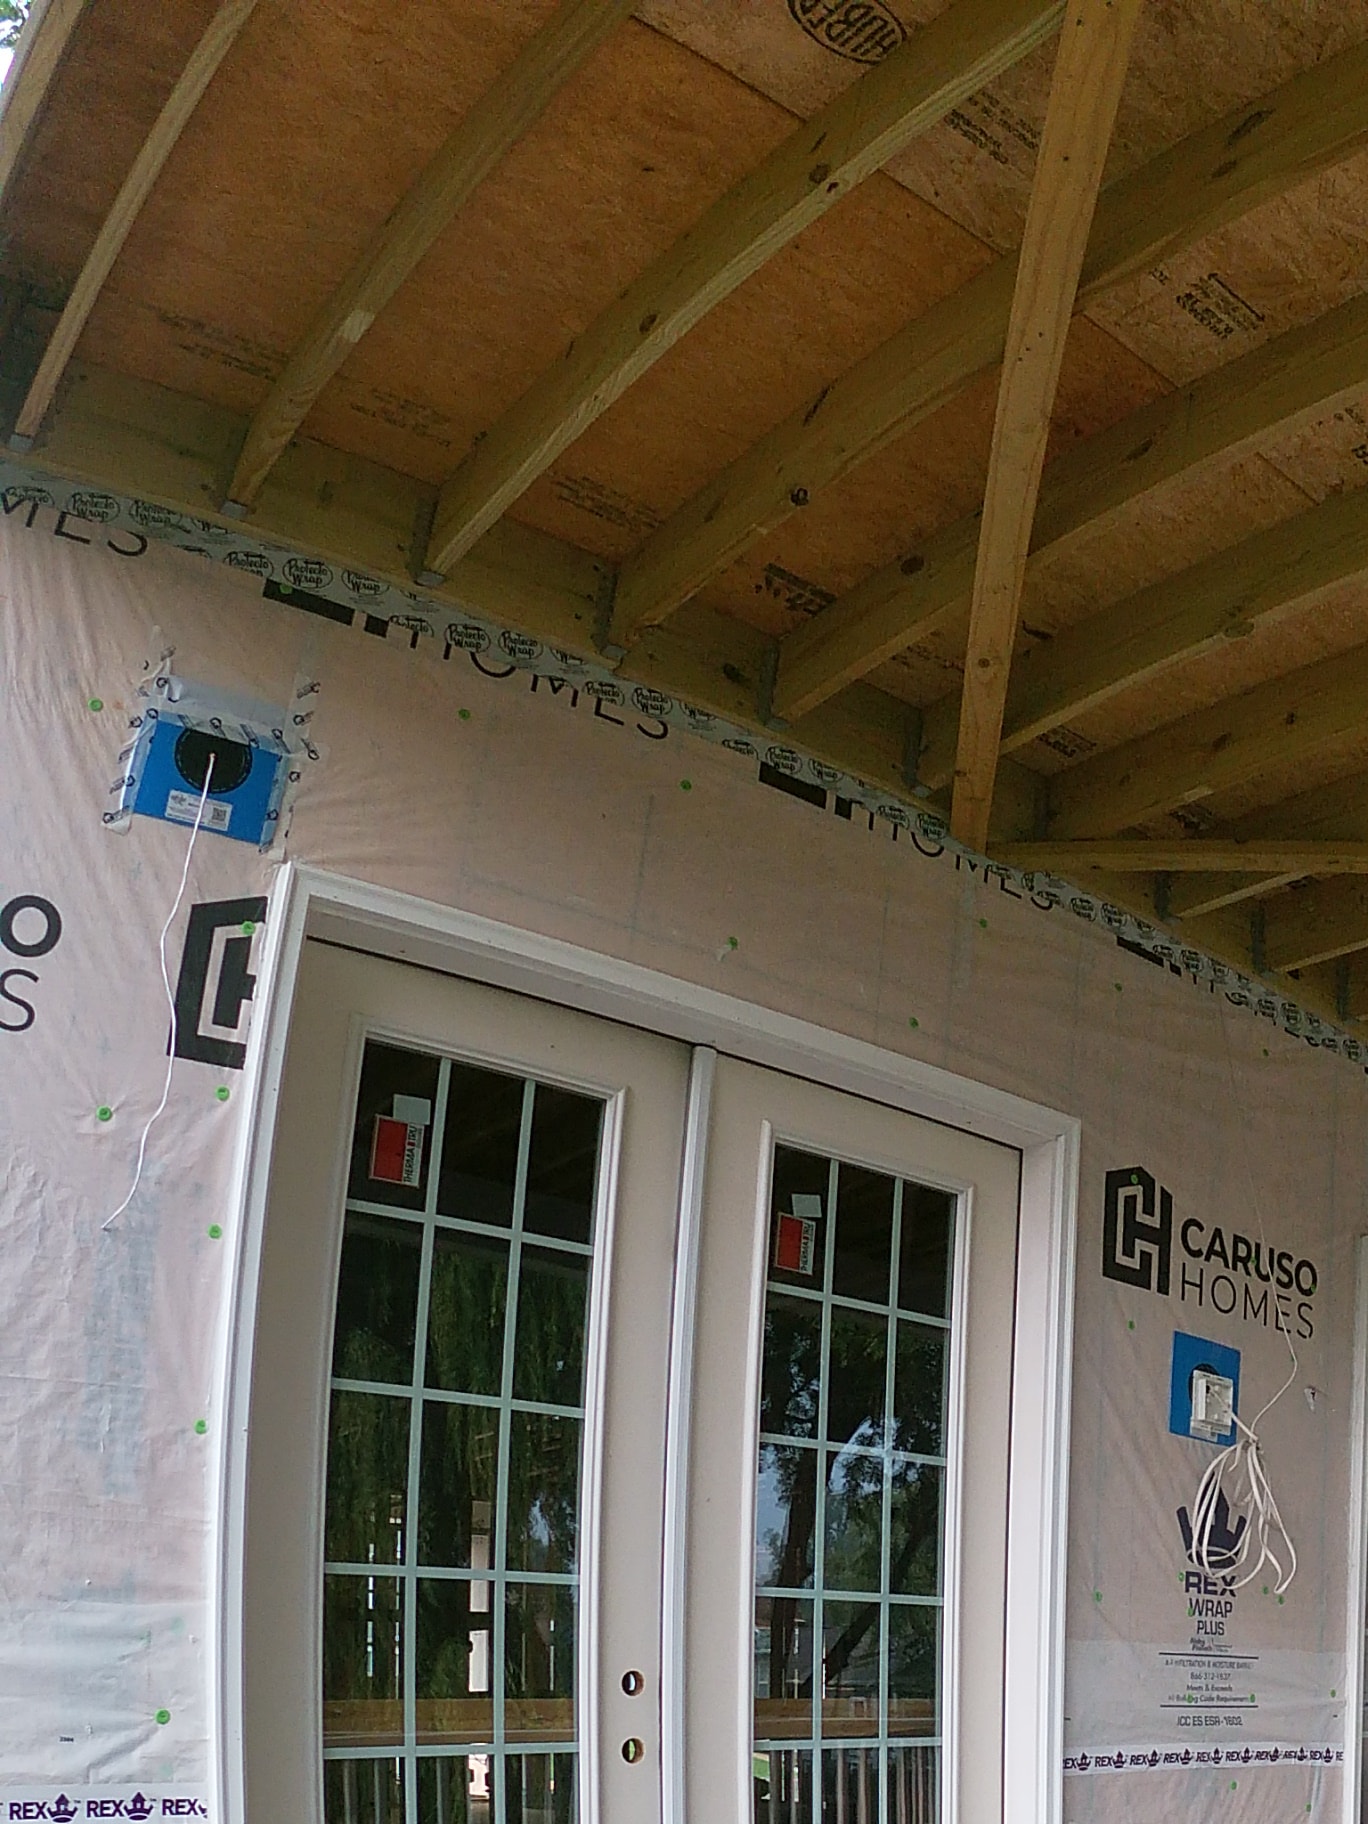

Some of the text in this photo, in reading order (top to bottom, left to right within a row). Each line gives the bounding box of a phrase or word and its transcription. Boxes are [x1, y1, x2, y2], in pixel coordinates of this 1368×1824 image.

[285, 558, 328, 577] Protecto
[291, 574, 323, 590] Wrap
[447, 622, 487, 641] Protecto
[1181, 1218, 1317, 1297] CARUSO
[1181, 1262, 1314, 1339] HOMES
[1185, 1571, 1236, 1597] REX
[1189, 1598, 1233, 1618] WRAP
[1197, 1620, 1225, 1635] PLUS
[1095, 1756, 1113, 1767] REX
[1130, 1754, 1149, 1766] REX
[1163, 1752, 1181, 1764] REX
[1196, 1752, 1211, 1762] REX
[1225, 1751, 1241, 1761] REX
[1255, 1751, 1270, 1760] REX
[1310, 1750, 1323, 1760] REX
[1336, 1751, 1344, 1760] RE
[9, 1799, 199, 1820] REX REX REX
